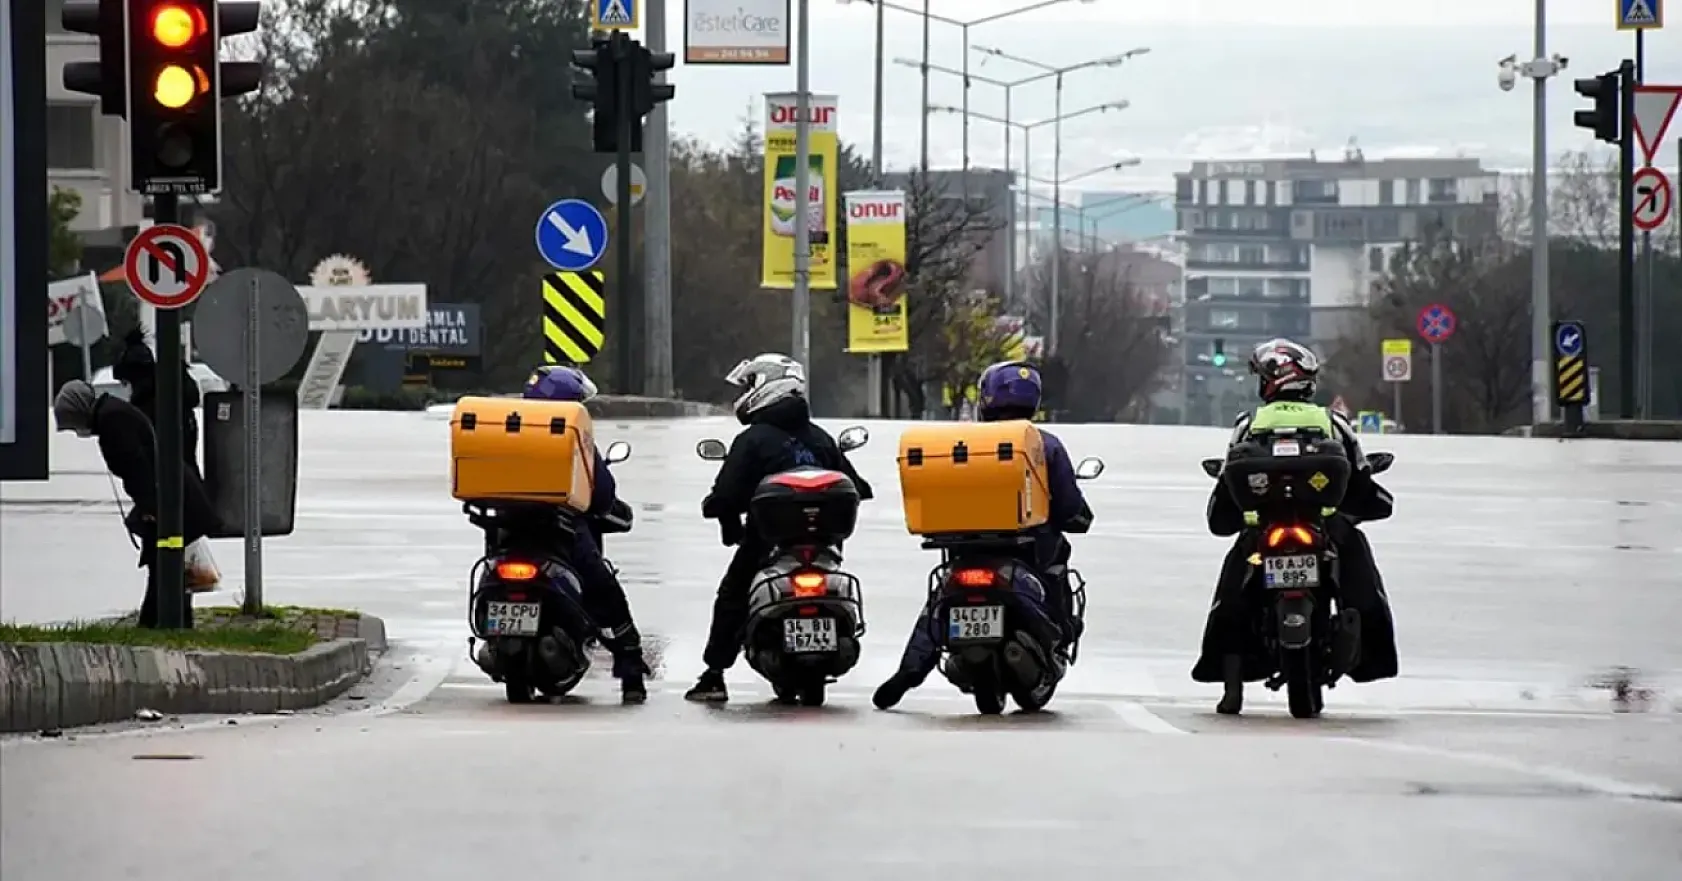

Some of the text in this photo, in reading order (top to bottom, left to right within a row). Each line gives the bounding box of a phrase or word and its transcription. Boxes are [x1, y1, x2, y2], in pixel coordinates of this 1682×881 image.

[850, 202, 902, 217] onur
[410, 328, 468, 344] DENTAL
[1267, 559, 1284, 570] 16
[1283, 570, 1308, 583] 895
[489, 604, 539, 618] 34 CPU
[499, 618, 522, 632] 671
[787, 620, 804, 633] 34
[964, 622, 990, 636] 280
